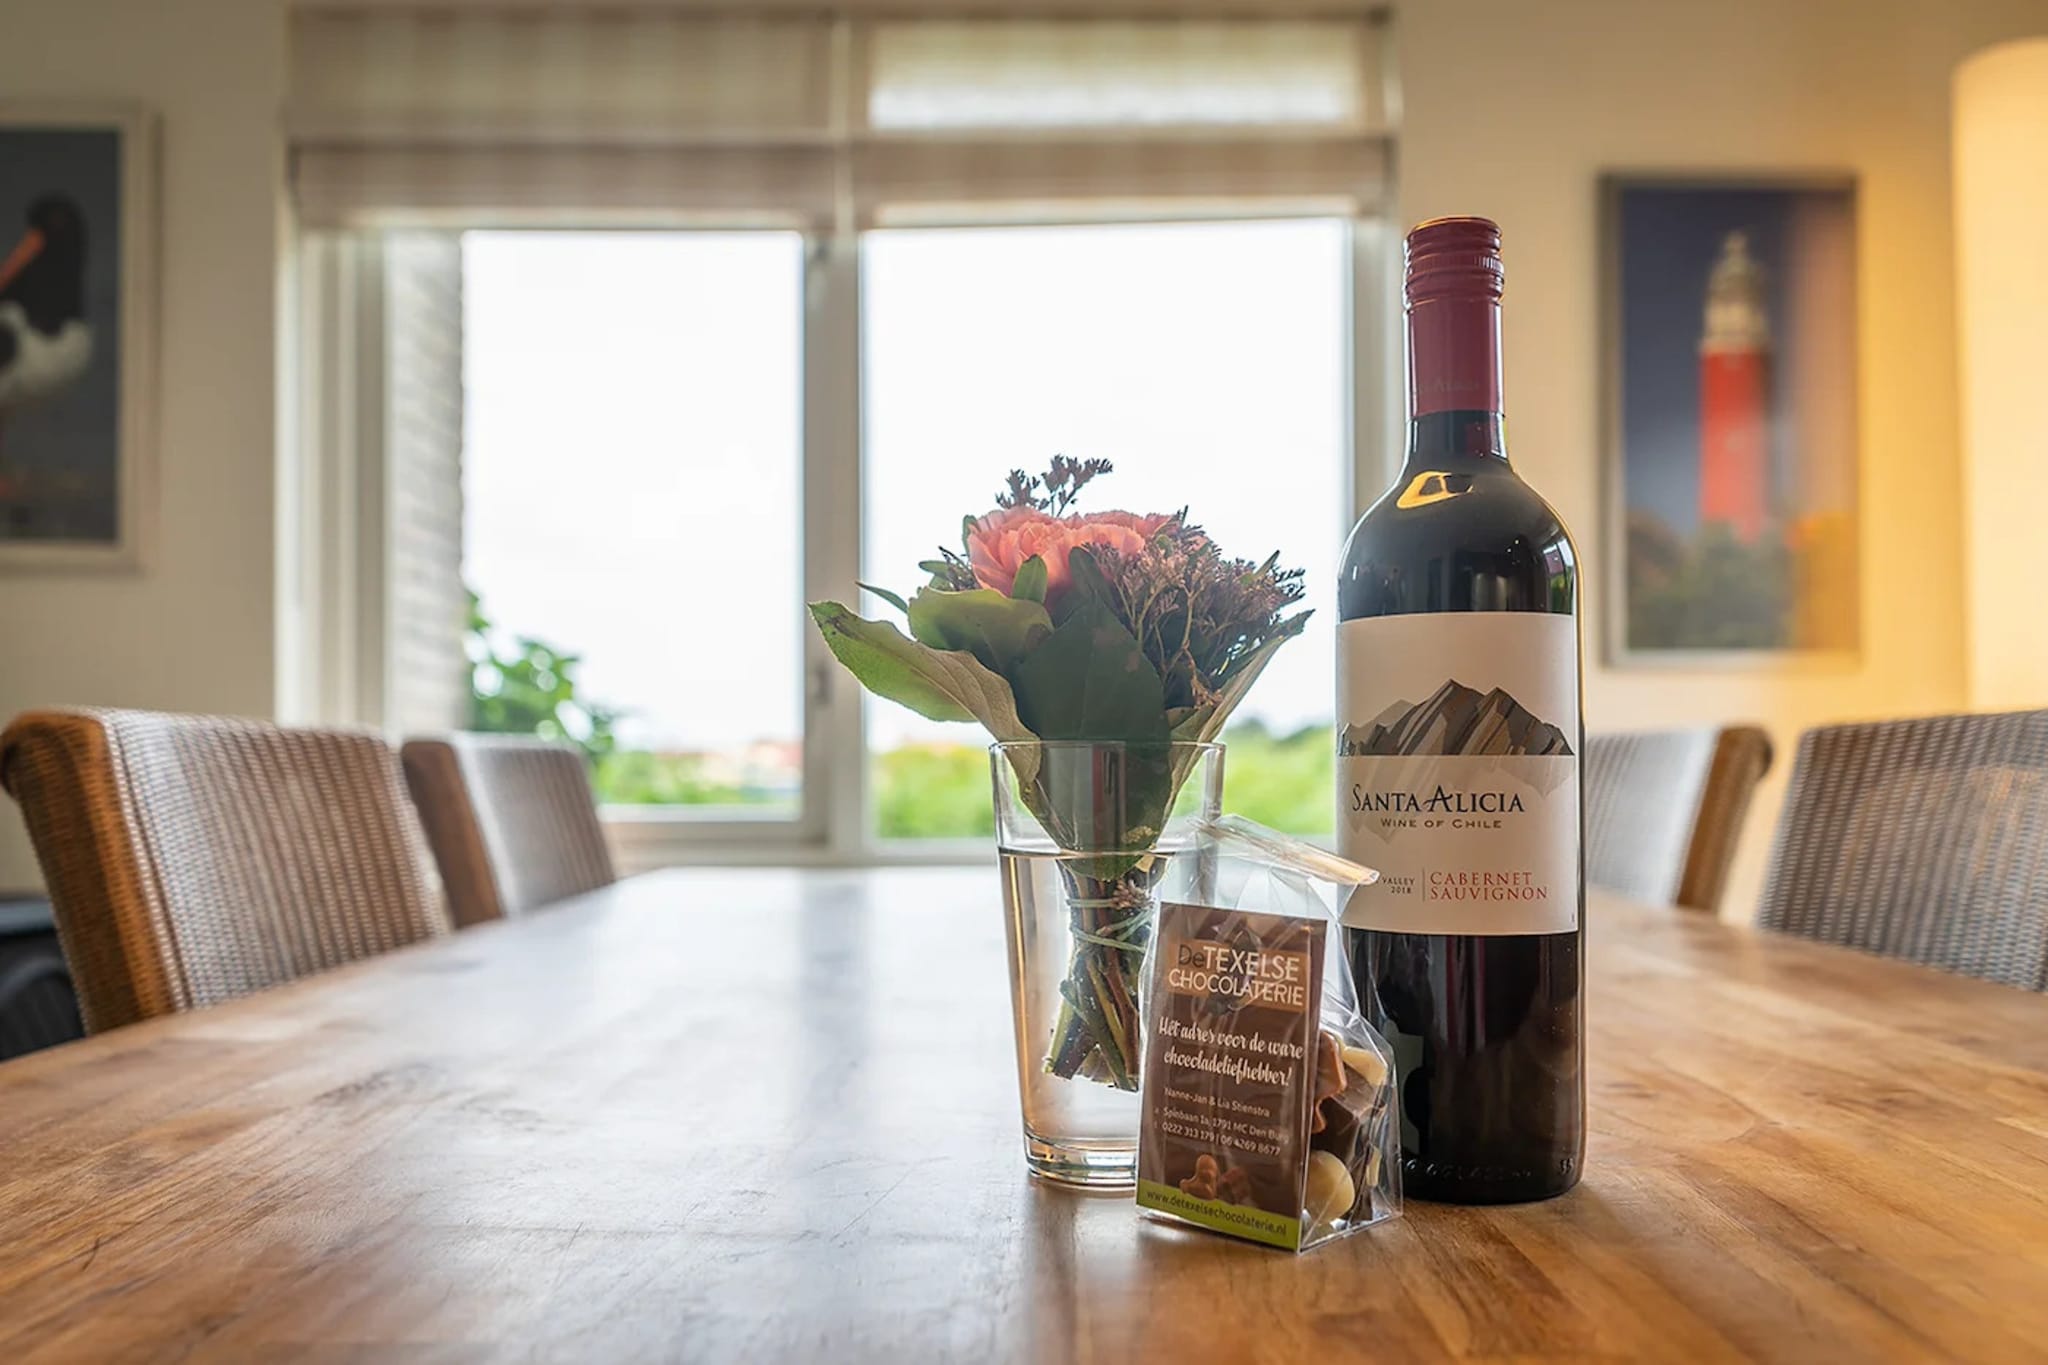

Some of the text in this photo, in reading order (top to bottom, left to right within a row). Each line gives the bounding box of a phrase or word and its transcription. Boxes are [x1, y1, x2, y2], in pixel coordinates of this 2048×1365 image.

[1352, 784, 1525, 813] SANTA ALICIA
[1381, 818, 1502, 829] WINE OF CHILE
[1383, 877, 1415, 886] VALLEY
[1391, 886, 1412, 894] 2018
[1430, 872, 1532, 886] CABERNET
[1430, 886, 1548, 902] SAUVIGNON
[1168, 968, 1304, 1006] CHOCOLATERIE
[1180, 1022, 1214, 1044] adres
[1217, 1033, 1247, 1049] voor
[1249, 1032, 1266, 1052] de
[1268, 1042, 1304, 1060] ware
[1164, 1046, 1292, 1087] chocoladeliefhebber!
[1164, 1087, 1270, 1118] Nanne-Jan & Lia Stienstra
[1162, 1121, 1183, 1136] 0222
[1184, 1126, 1199, 1139] 313
[1220, 1134, 1233, 1146] 06
[1213, 1118, 1232, 1131] 1791
[1233, 1122, 1248, 1135] MC
[1249, 1125, 1266, 1138] Den
[1146, 1190, 1287, 1236] www.detexelsechocolaterie.nl
